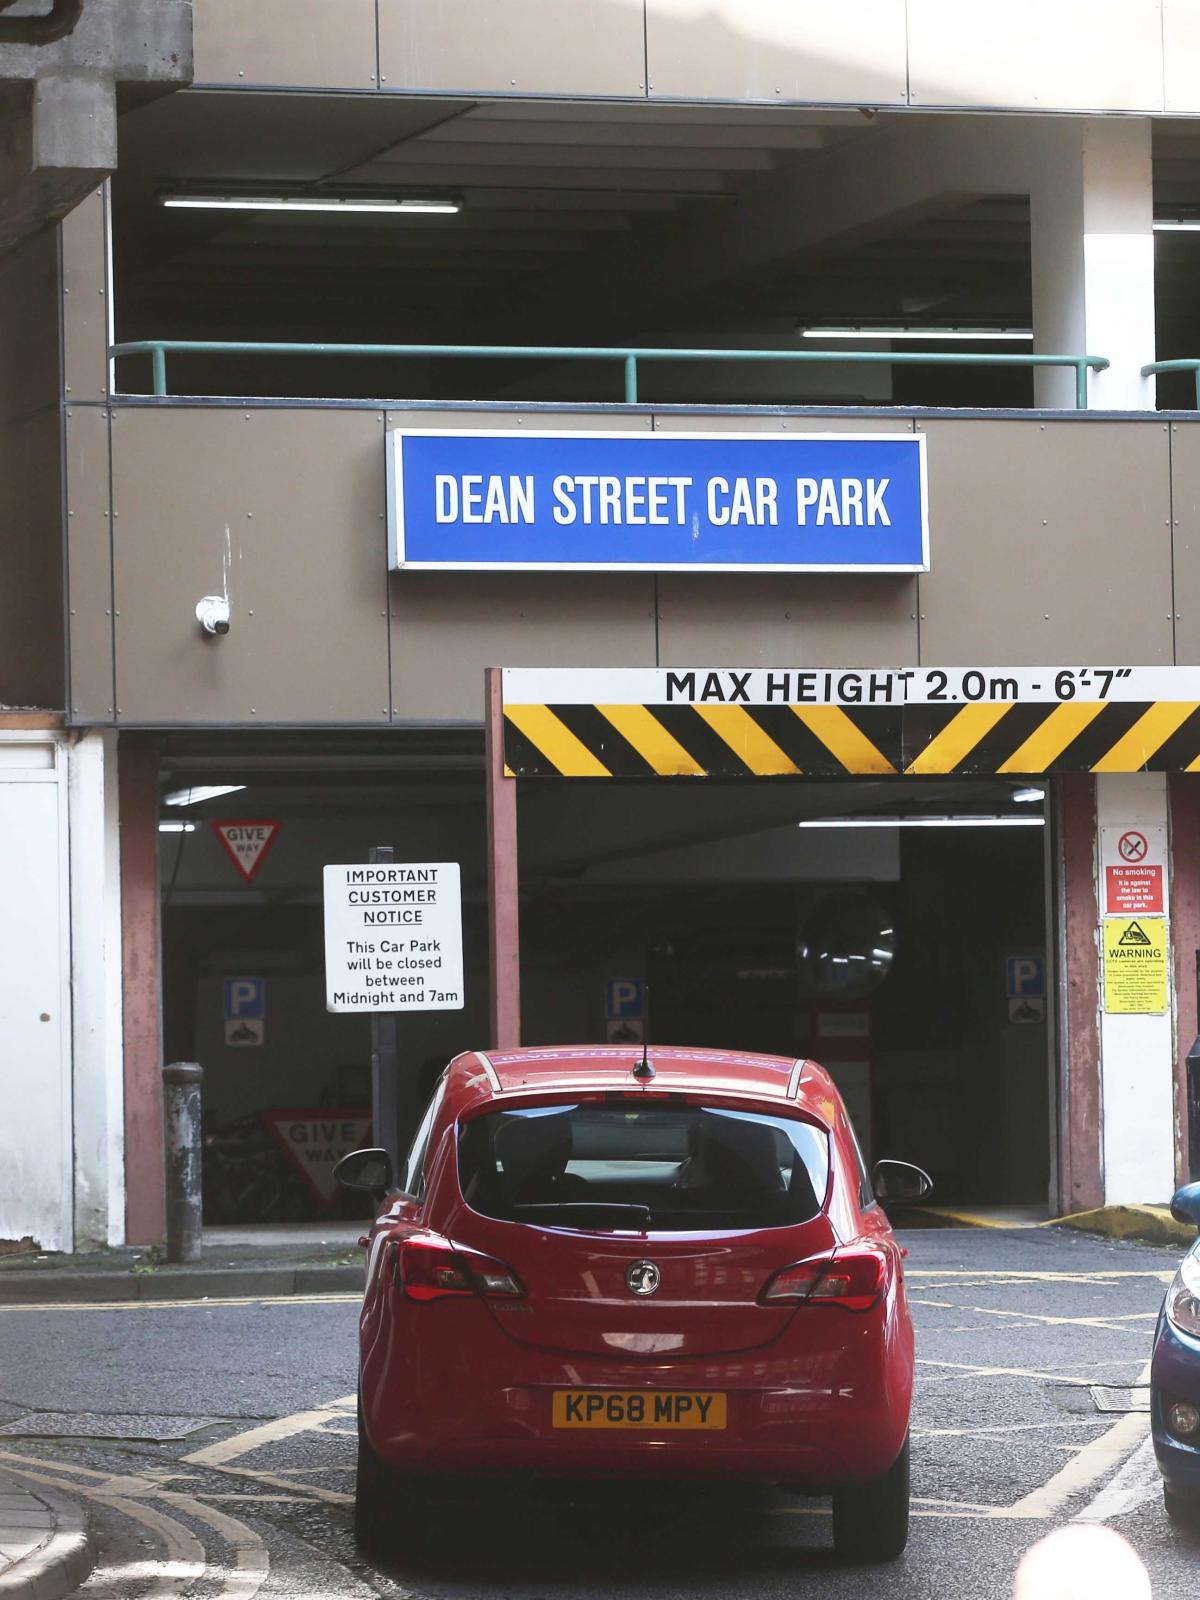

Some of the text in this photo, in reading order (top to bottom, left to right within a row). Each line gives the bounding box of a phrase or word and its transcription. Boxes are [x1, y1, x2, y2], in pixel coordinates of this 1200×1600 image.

[434, 474, 891, 527] DEAN STREET CAR PARK
[666, 672, 752, 702] MAX
[766, 670, 915, 703] HEIGHT
[926, 670, 1018, 700] 2.0m
[227, 828, 265, 840] GIVE
[236, 844, 259, 852] WAY
[346, 869, 438, 883] IMPORTANT
[1125, 868, 1156, 877] smoking
[348, 890, 436, 903] CUSTOMER
[364, 910, 423, 923] NOTICE
[347, 939, 441, 953] This Car Park
[1109, 949, 1161, 958] WARNING
[347, 957, 442, 970] will be closed
[366, 975, 424, 986] between
[1014, 961, 1037, 992] P
[231, 982, 256, 1014] P
[333, 990, 458, 1005] Midnight and 7am
[613, 983, 637, 1014] P
[289, 1124, 355, 1142] GIVE
[566, 1394, 713, 1423] KP68 MPY
